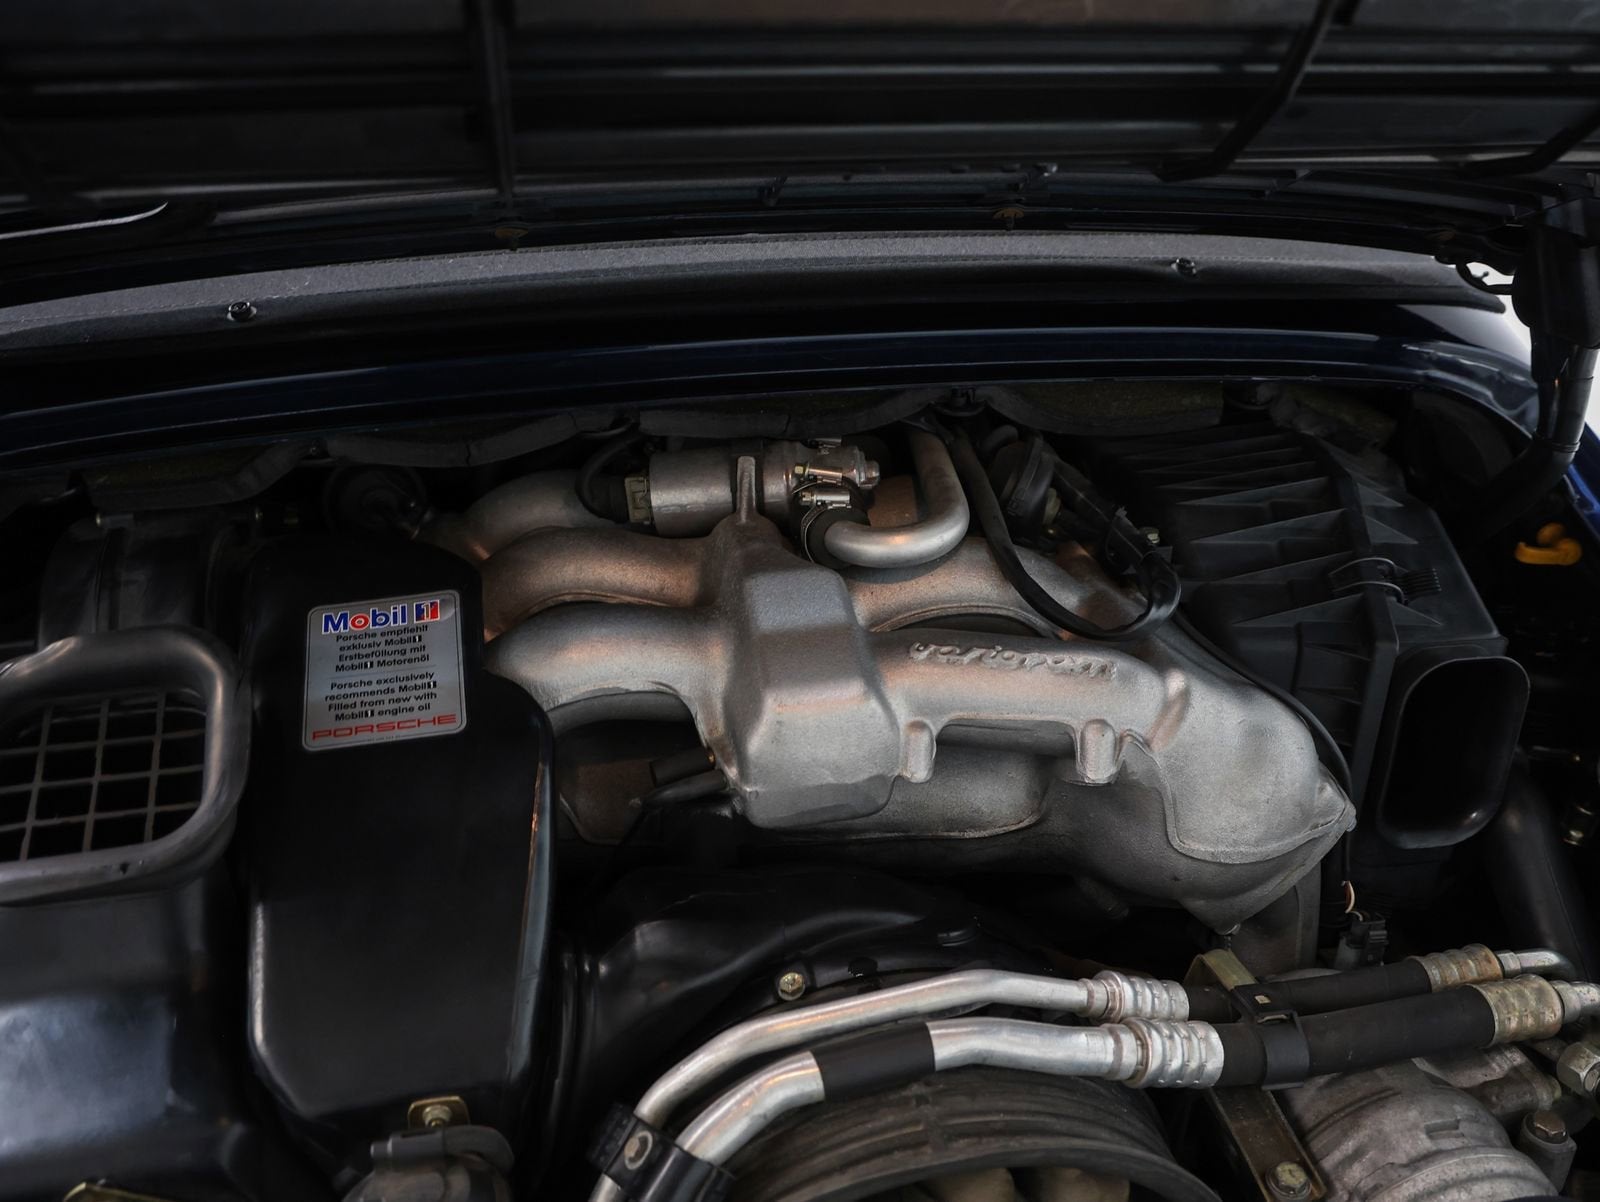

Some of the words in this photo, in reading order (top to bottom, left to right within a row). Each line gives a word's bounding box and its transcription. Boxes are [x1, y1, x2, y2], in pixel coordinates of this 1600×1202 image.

[322, 604, 407, 634] Mobil
[336, 632, 377, 642] Porsche
[381, 625, 428, 637] empfiehlt
[339, 649, 407, 662] Erstbefüllung
[410, 645, 426, 653] mit
[340, 641, 381, 652] exklusiv
[377, 655, 429, 667] Motorenöl
[331, 680, 372, 690] Porsche
[376, 671, 435, 685] exclusively
[325, 687, 395, 701] recommends
[328, 702, 357, 712] Filled
[361, 699, 385, 708] from
[388, 696, 411, 704] new
[415, 692, 437, 700] with
[378, 708, 414, 718] engine
[418, 703, 431, 711] oil
[312, 714, 456, 741] PORSCHE
